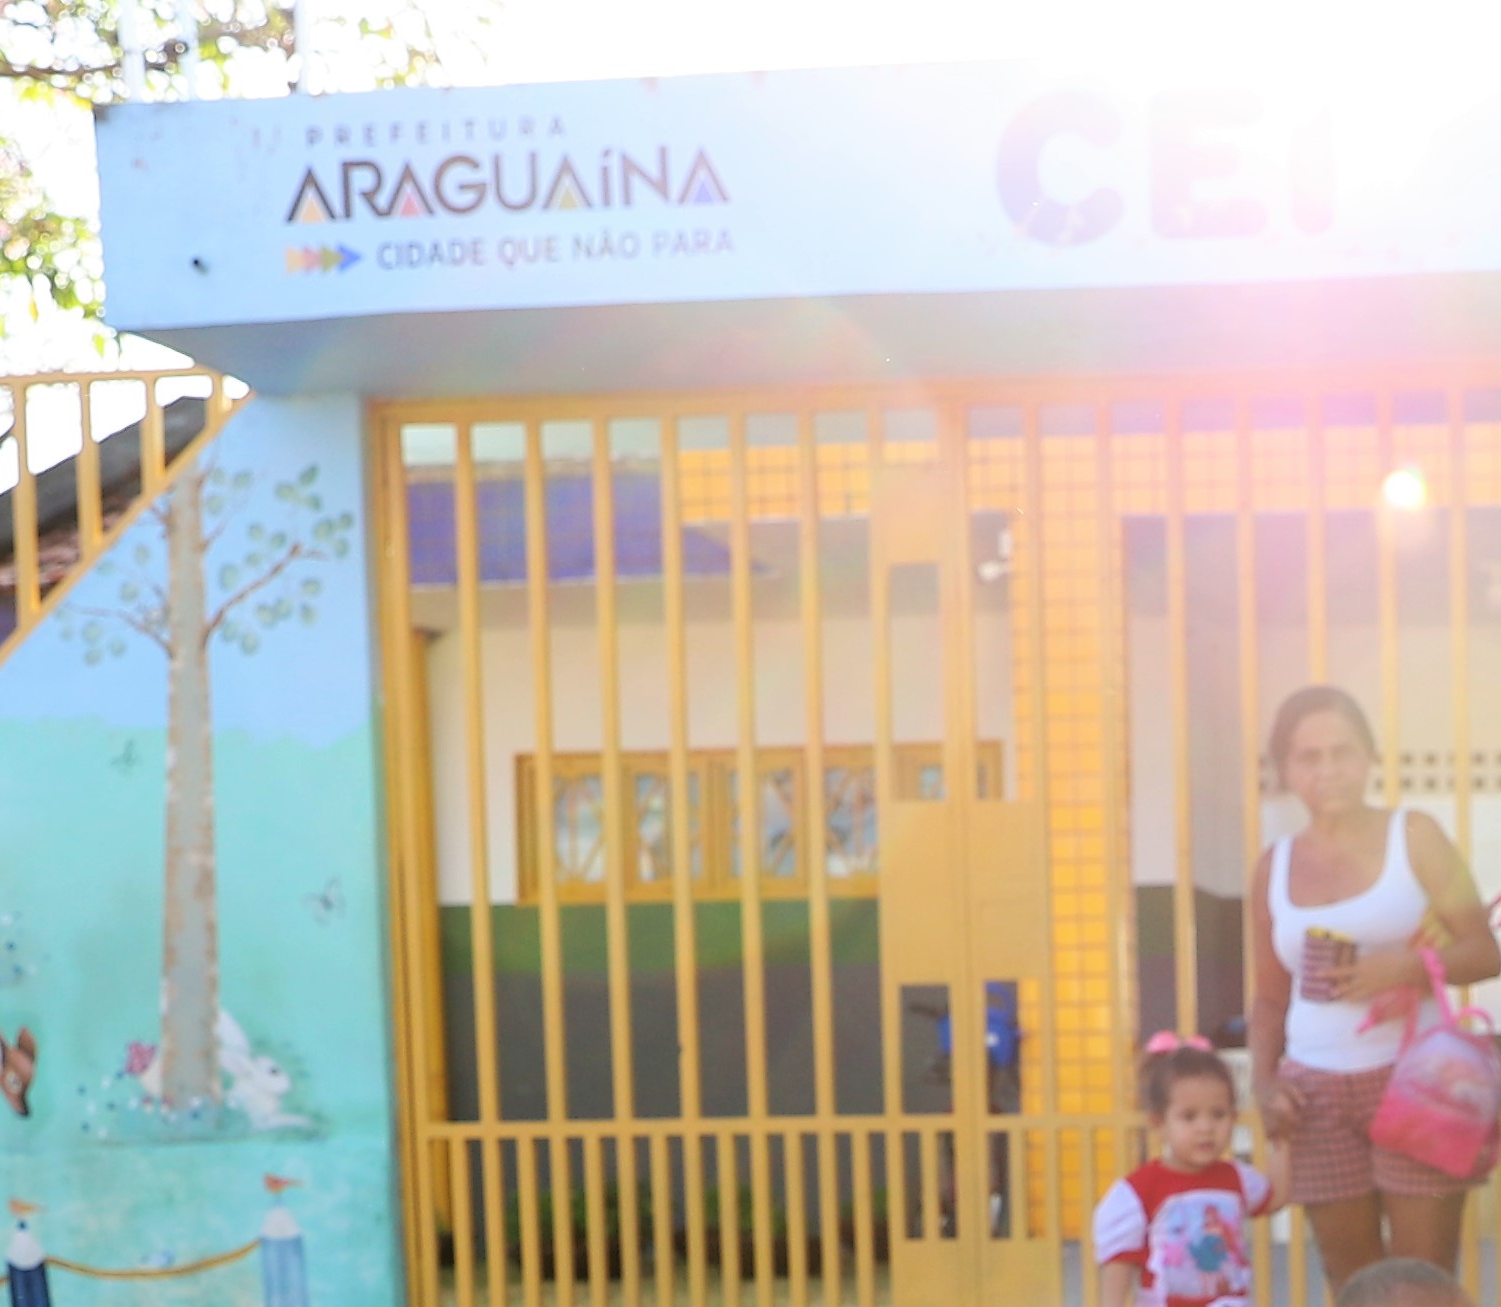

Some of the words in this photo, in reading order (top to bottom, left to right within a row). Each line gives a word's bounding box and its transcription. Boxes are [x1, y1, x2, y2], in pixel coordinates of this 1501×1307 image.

[305, 116, 567, 148] PREFEITURA
[376, 238, 487, 271] CIDADE
[497, 236, 560, 270] QUE
[572, 231, 641, 262] NÃO
[652, 228, 735, 258] PARA
